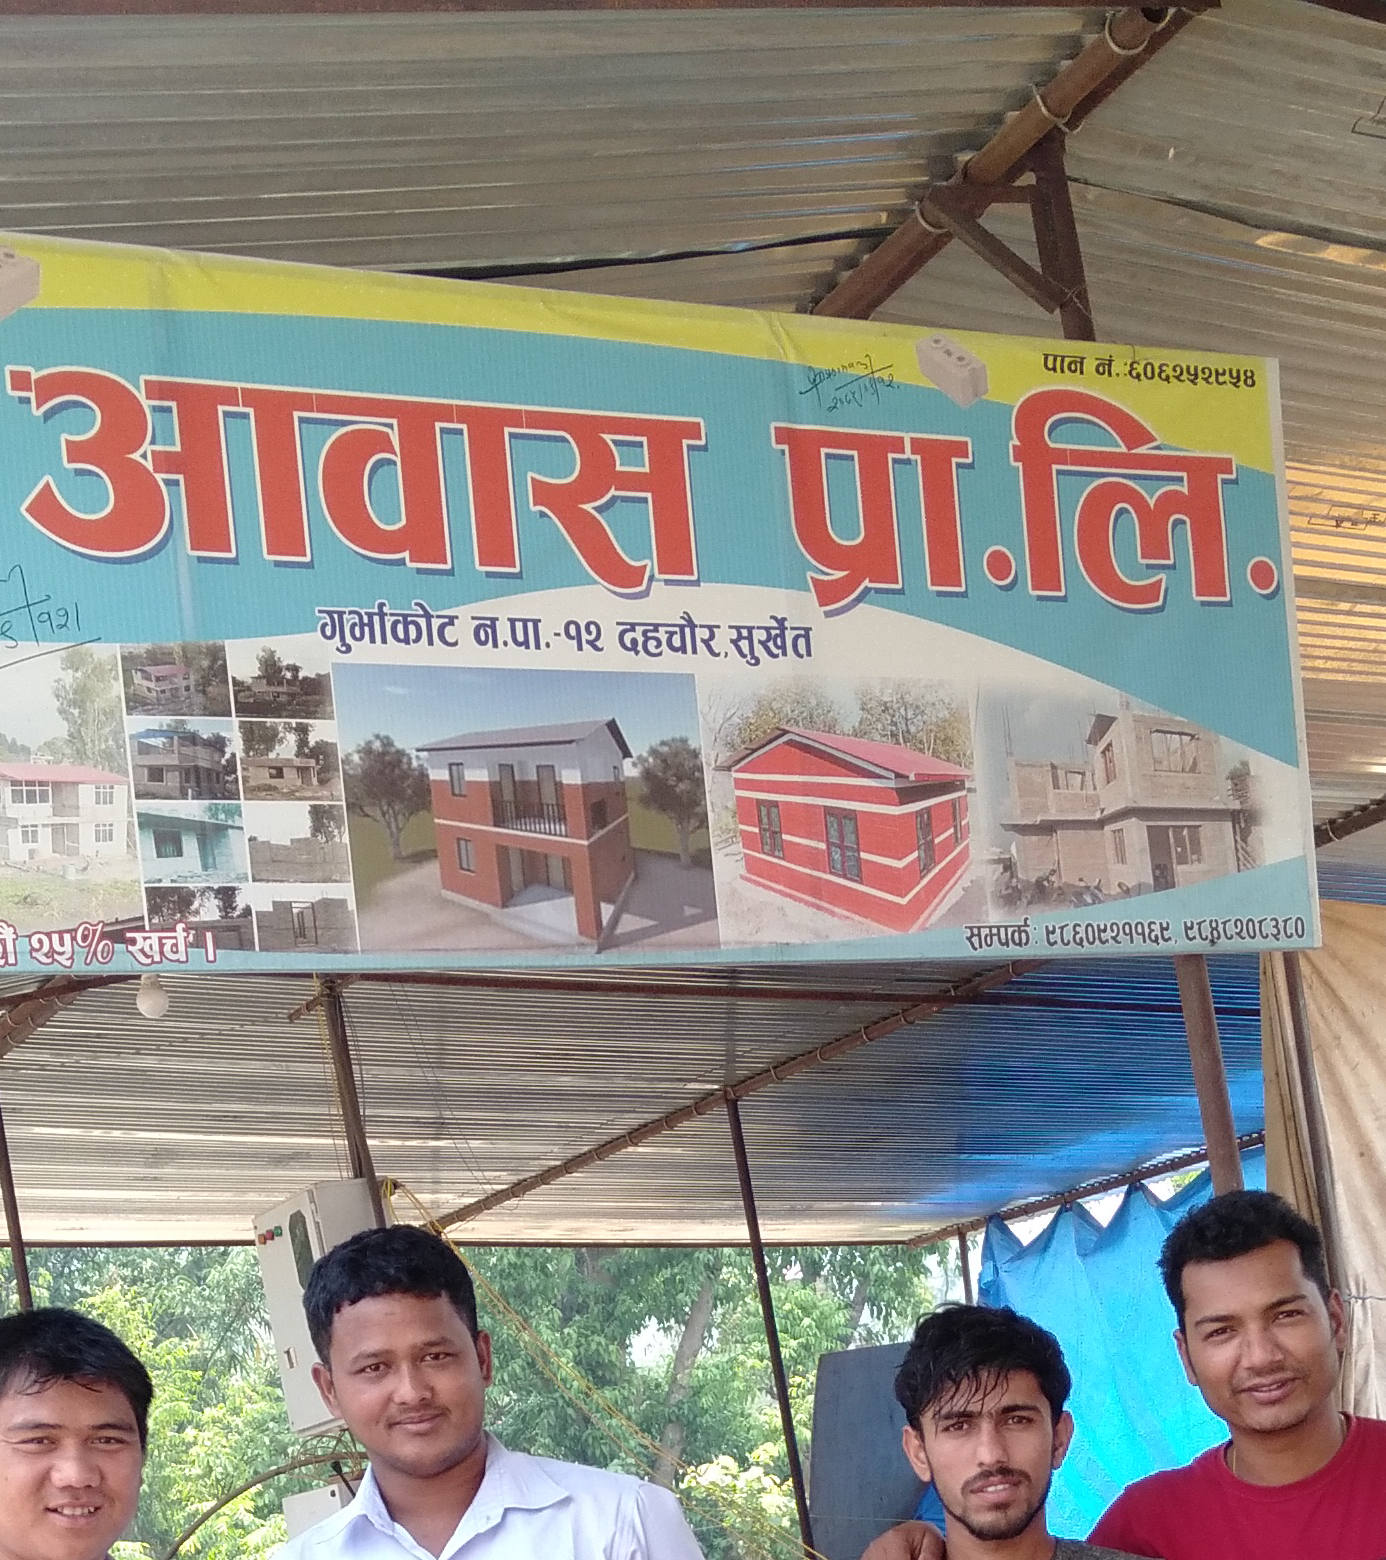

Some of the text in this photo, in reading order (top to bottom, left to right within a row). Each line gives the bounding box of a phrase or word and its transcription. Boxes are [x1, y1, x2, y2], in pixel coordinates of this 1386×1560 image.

[1043, 353, 1086, 376] पान
[6, 364, 708, 597] आवास
[770, 386, 1280, 618] प्रा.लि.
[317, 601, 459, 655] गुर्भाकोट
[30, 921, 114, 969] २५%
[125, 922, 189, 966] खर्च
